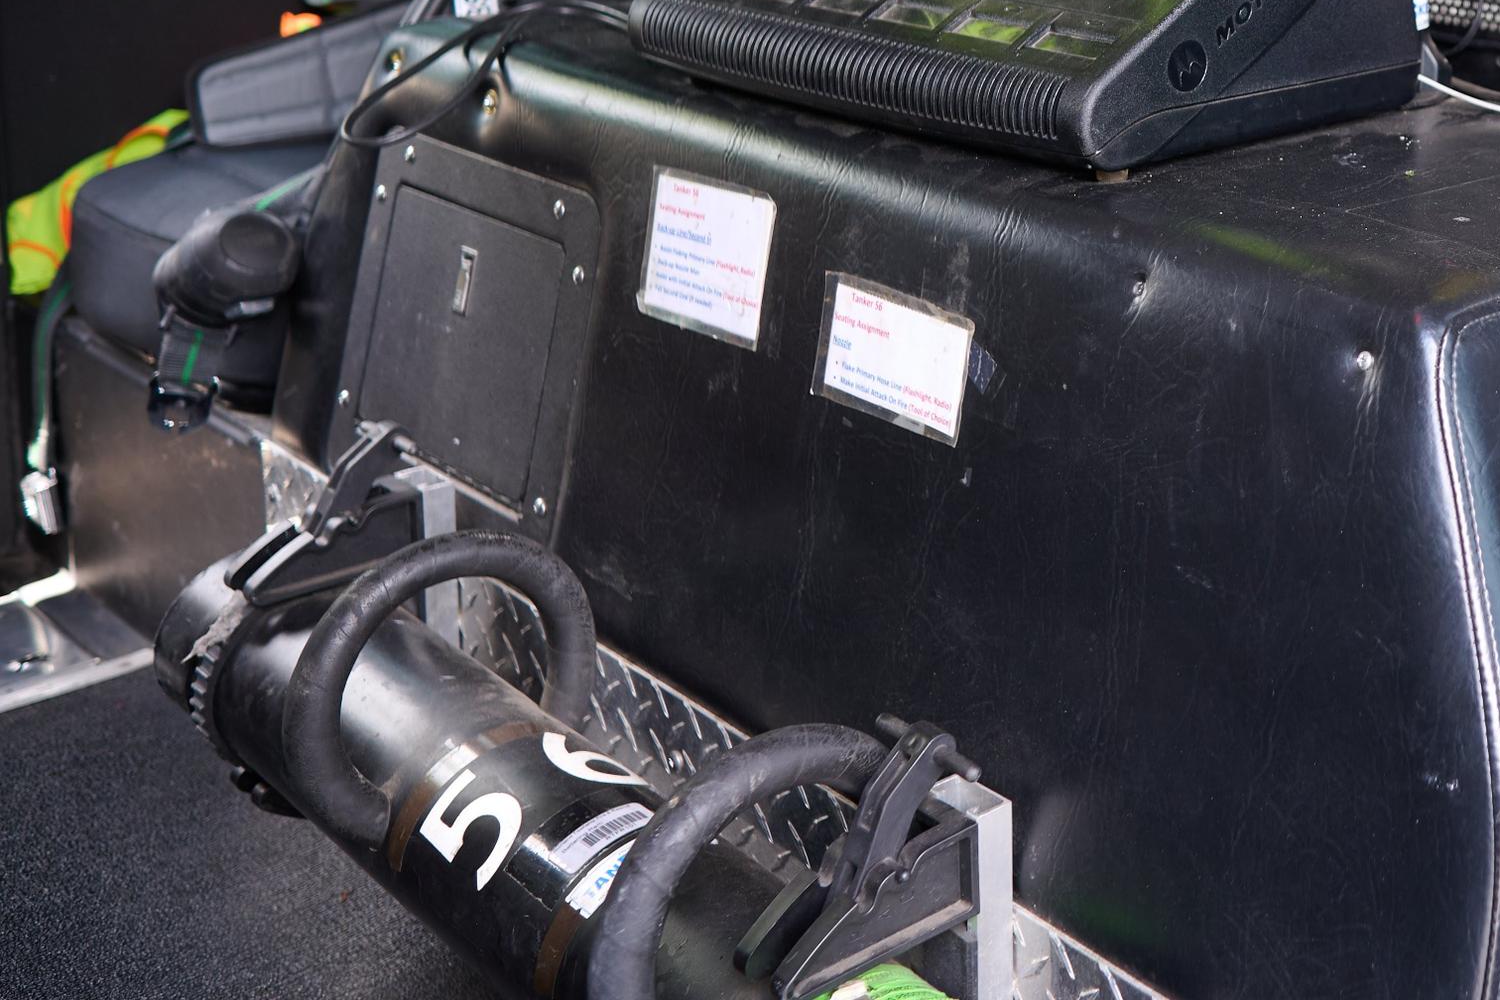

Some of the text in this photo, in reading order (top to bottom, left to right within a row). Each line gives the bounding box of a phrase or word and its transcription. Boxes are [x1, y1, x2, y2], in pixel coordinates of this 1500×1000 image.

[852, 292, 883, 312] Tanker 56
[834, 312, 890, 338] Seating Assignment
[833, 335, 852, 349] Nozzle
[840, 376, 854, 388] Make
[871, 389, 887, 401] Attack
[888, 396, 896, 406] On
[898, 399, 908, 409] Fire
[908, 403, 924, 416] (Tool
[924, 410, 930, 418] of
[842, 361, 855, 373] Flake
[856, 367, 875, 381] Primary
[891, 380, 902, 391] Line
[902, 385, 933, 402] (Flashlight,
[934, 397, 952, 412] Radio)
